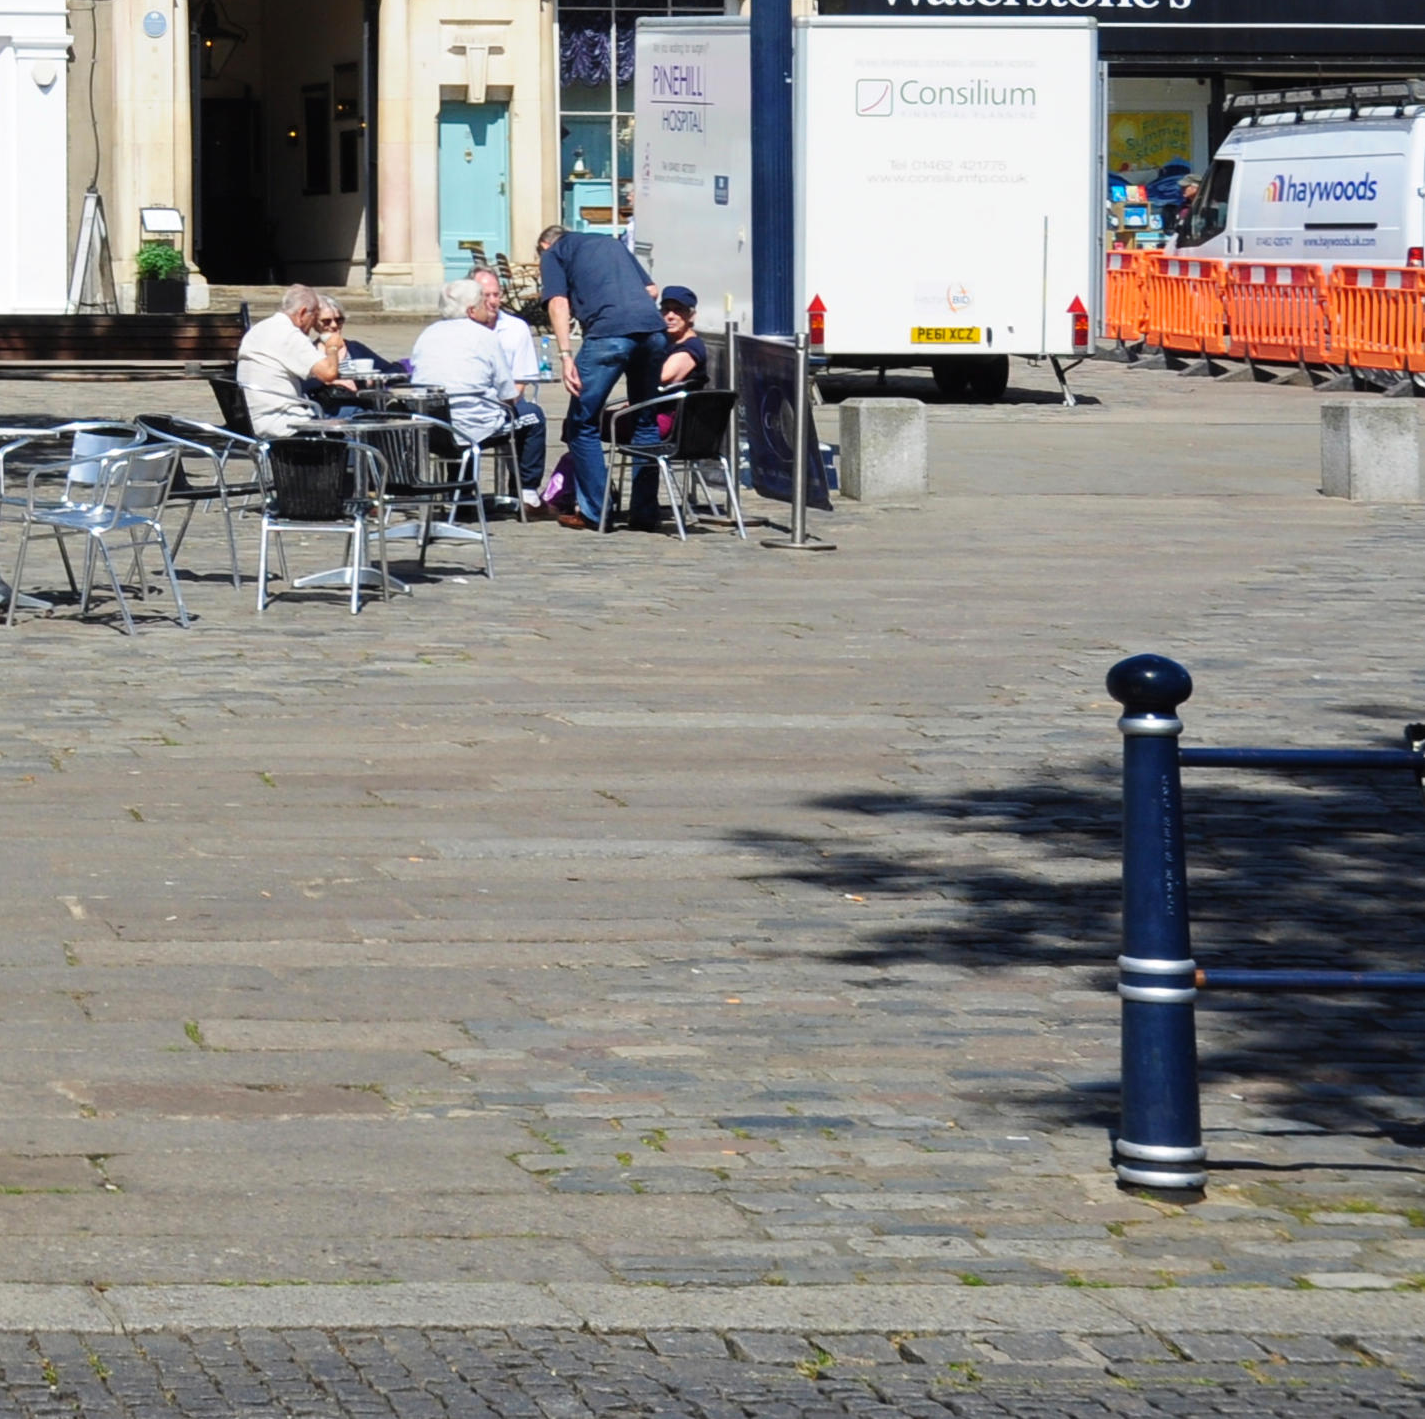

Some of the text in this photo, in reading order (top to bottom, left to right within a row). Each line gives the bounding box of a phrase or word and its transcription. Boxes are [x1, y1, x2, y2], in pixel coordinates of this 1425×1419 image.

[653, 65, 703, 96] PINEHILL
[900, 79, 1036, 106] Consilium
[662, 110, 703, 133] HOSPITAL
[888, 160, 907, 171] Tel
[1286, 171, 1377, 208] haywoods
[917, 328, 974, 341] PE61 XCZ
